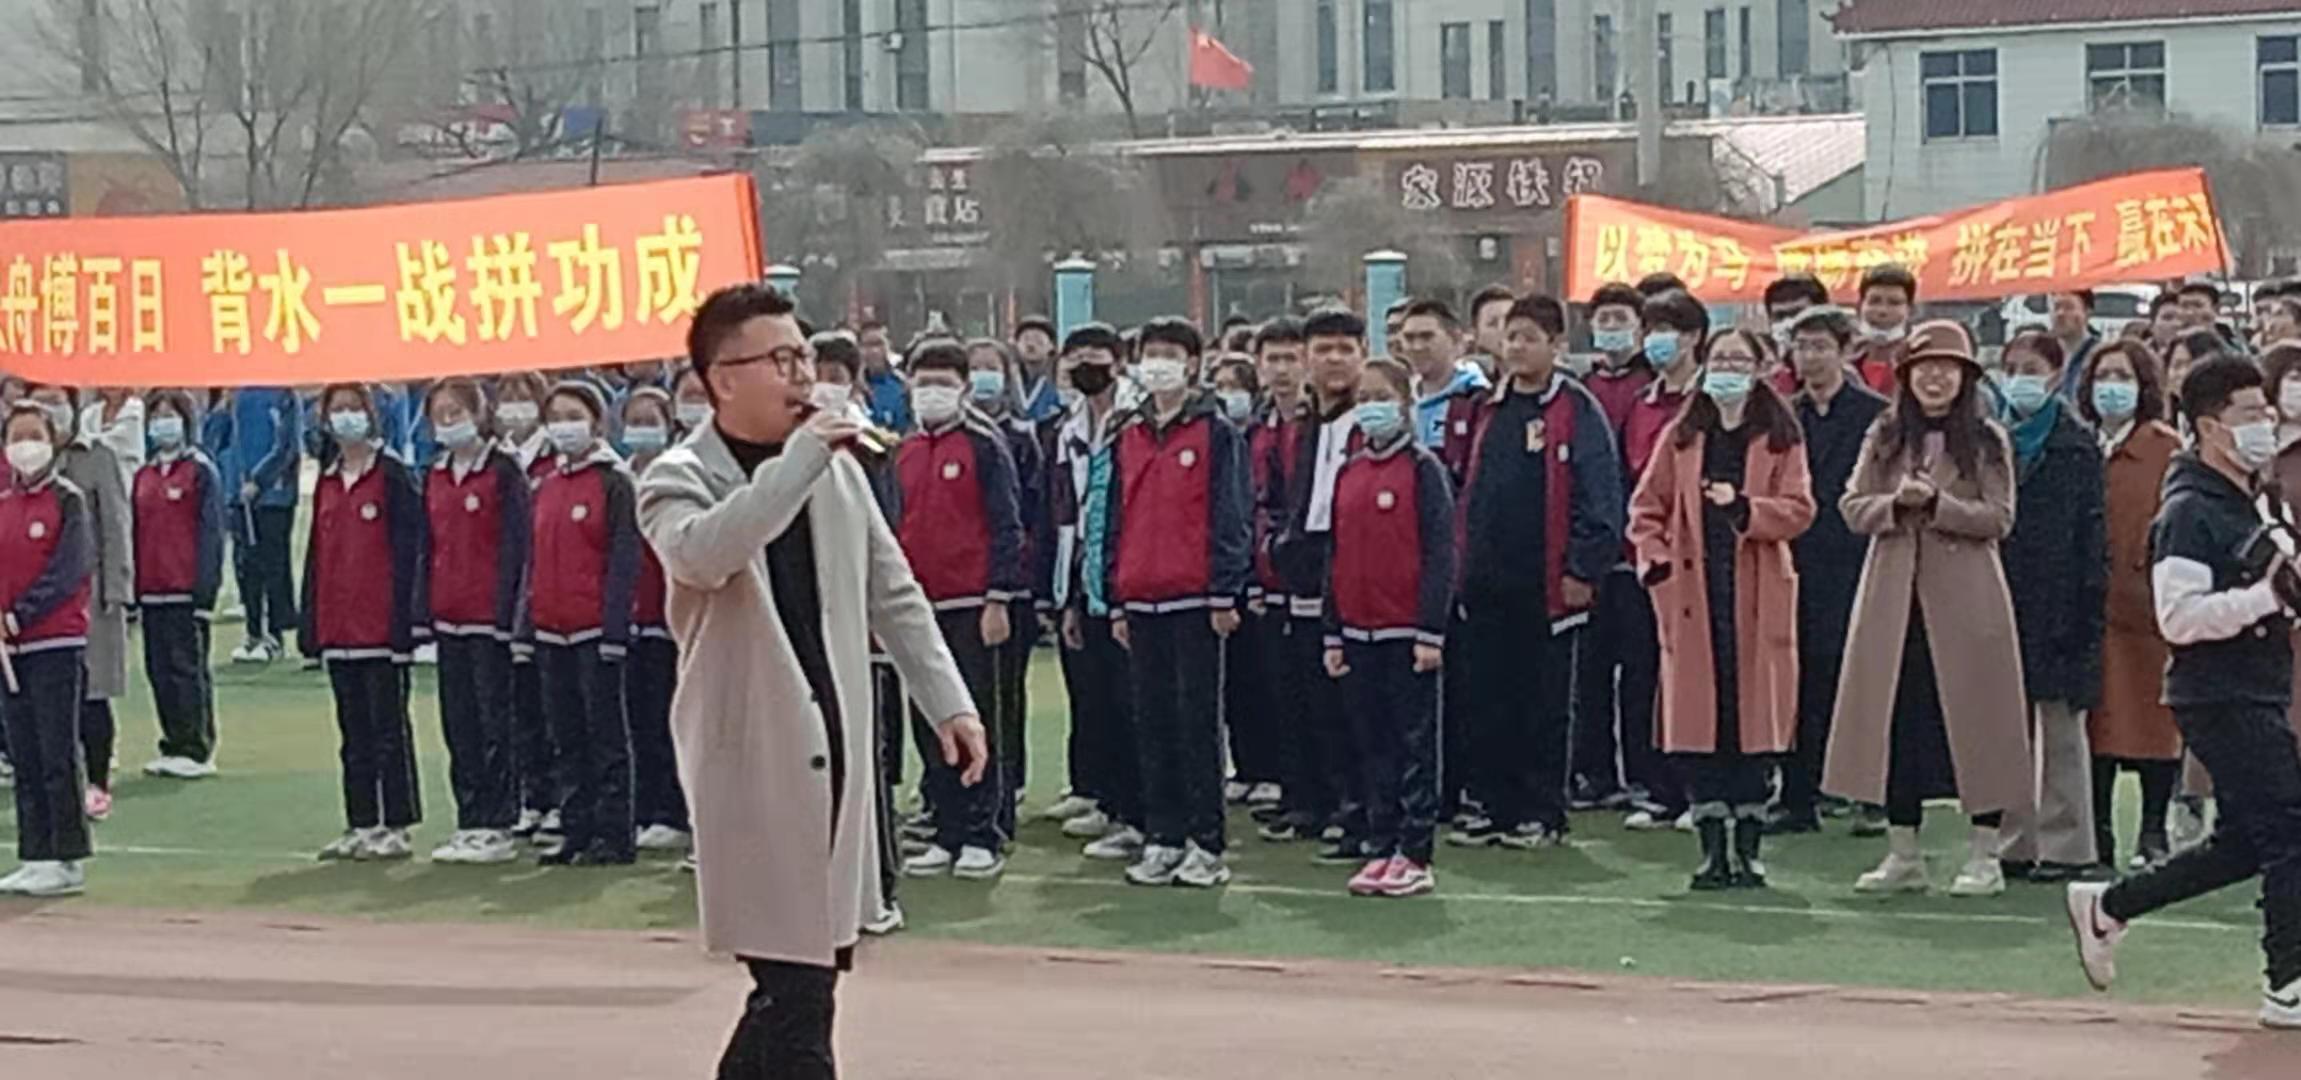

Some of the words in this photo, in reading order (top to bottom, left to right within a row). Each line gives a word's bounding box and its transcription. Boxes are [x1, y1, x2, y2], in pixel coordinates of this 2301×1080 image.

[0, 252, 165, 356] 舟博百日
[202, 214, 706, 356] 背水一战拼功成
[1949, 211, 2096, 286] 拼在当下
